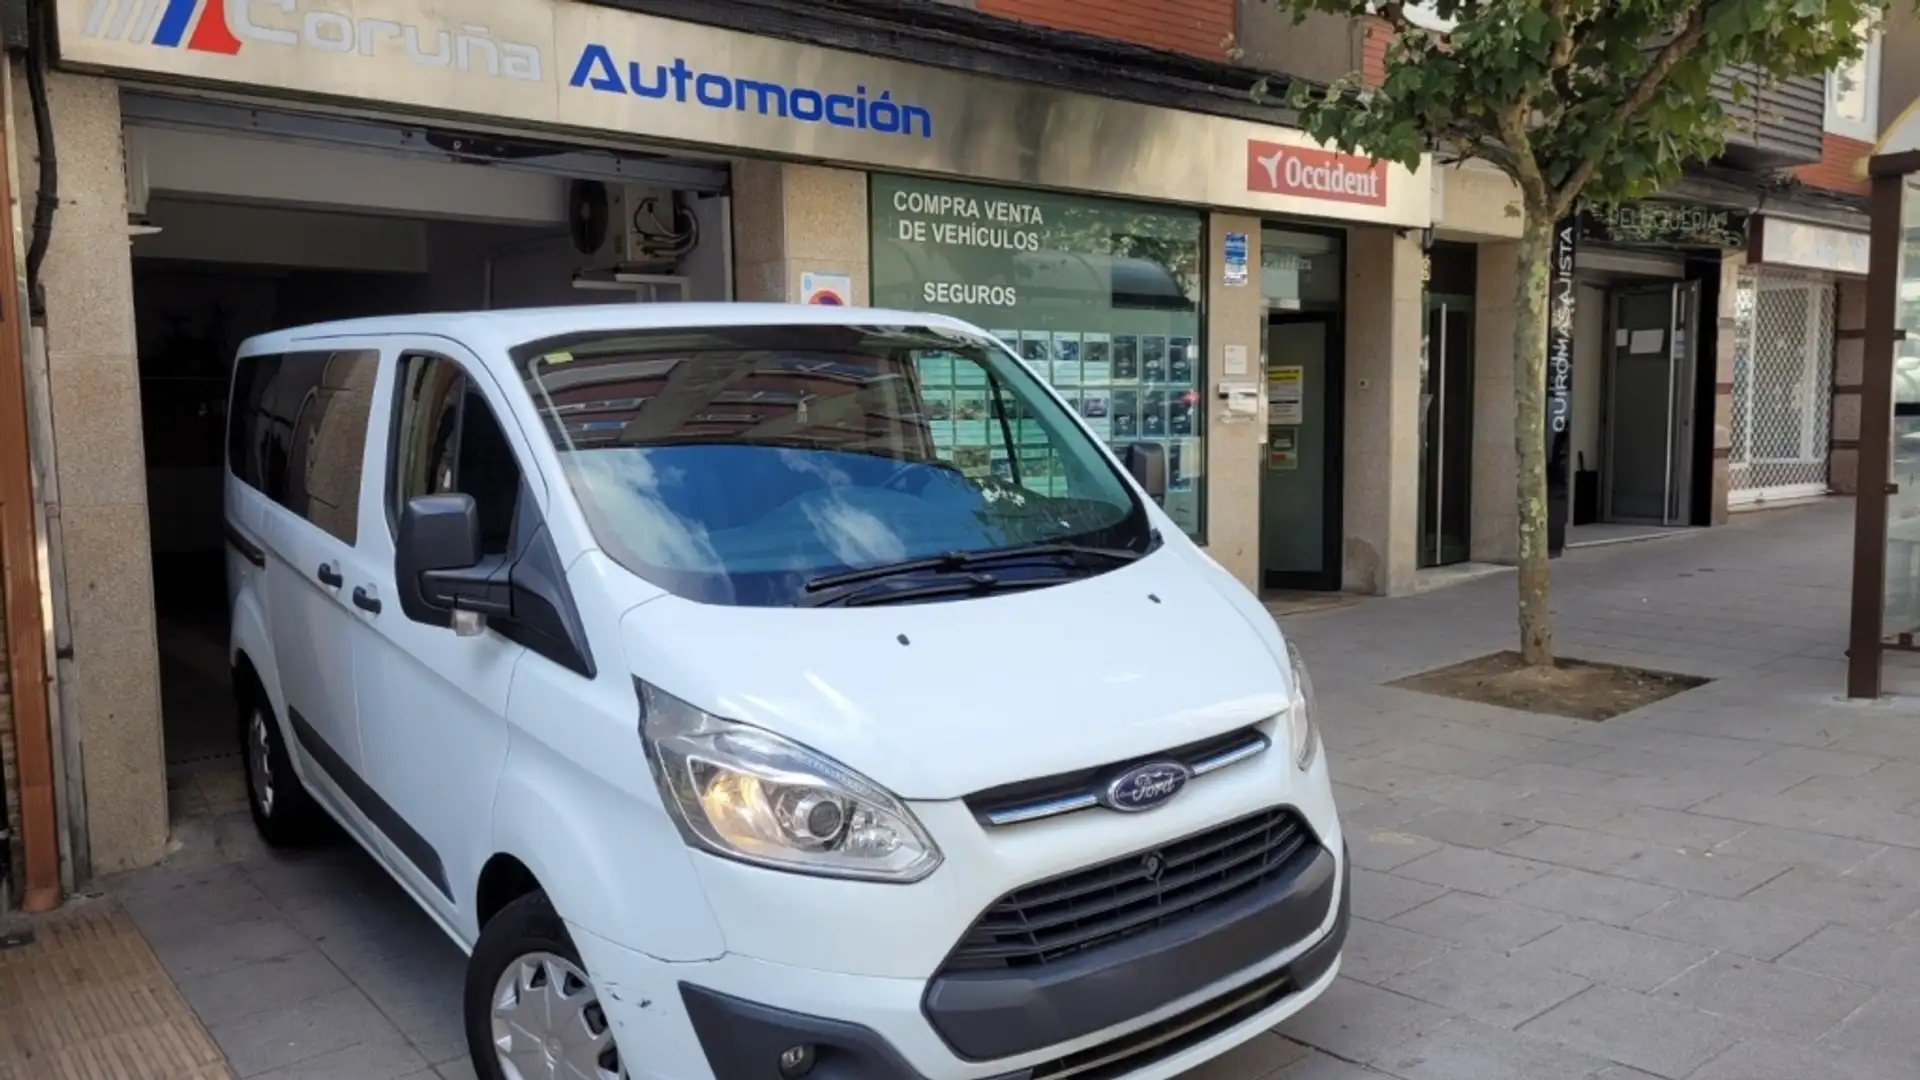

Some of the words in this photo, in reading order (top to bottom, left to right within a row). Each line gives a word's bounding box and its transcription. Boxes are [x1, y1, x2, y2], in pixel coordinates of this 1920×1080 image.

[231, 0, 542, 81] Coruña
[569, 43, 932, 138] Automoción
[1285, 155, 1380, 198] Occident
[893, 190, 980, 218] COMPRA
[984, 201, 1044, 225] VENTA
[899, 219, 926, 242] DE
[931, 222, 1039, 251] VEHÍCULOS
[923, 281, 1017, 307] SEGUROS
[1553, 226, 1574, 433] QUIROMASAJISTA
[1131, 770, 1175, 802] Ford
